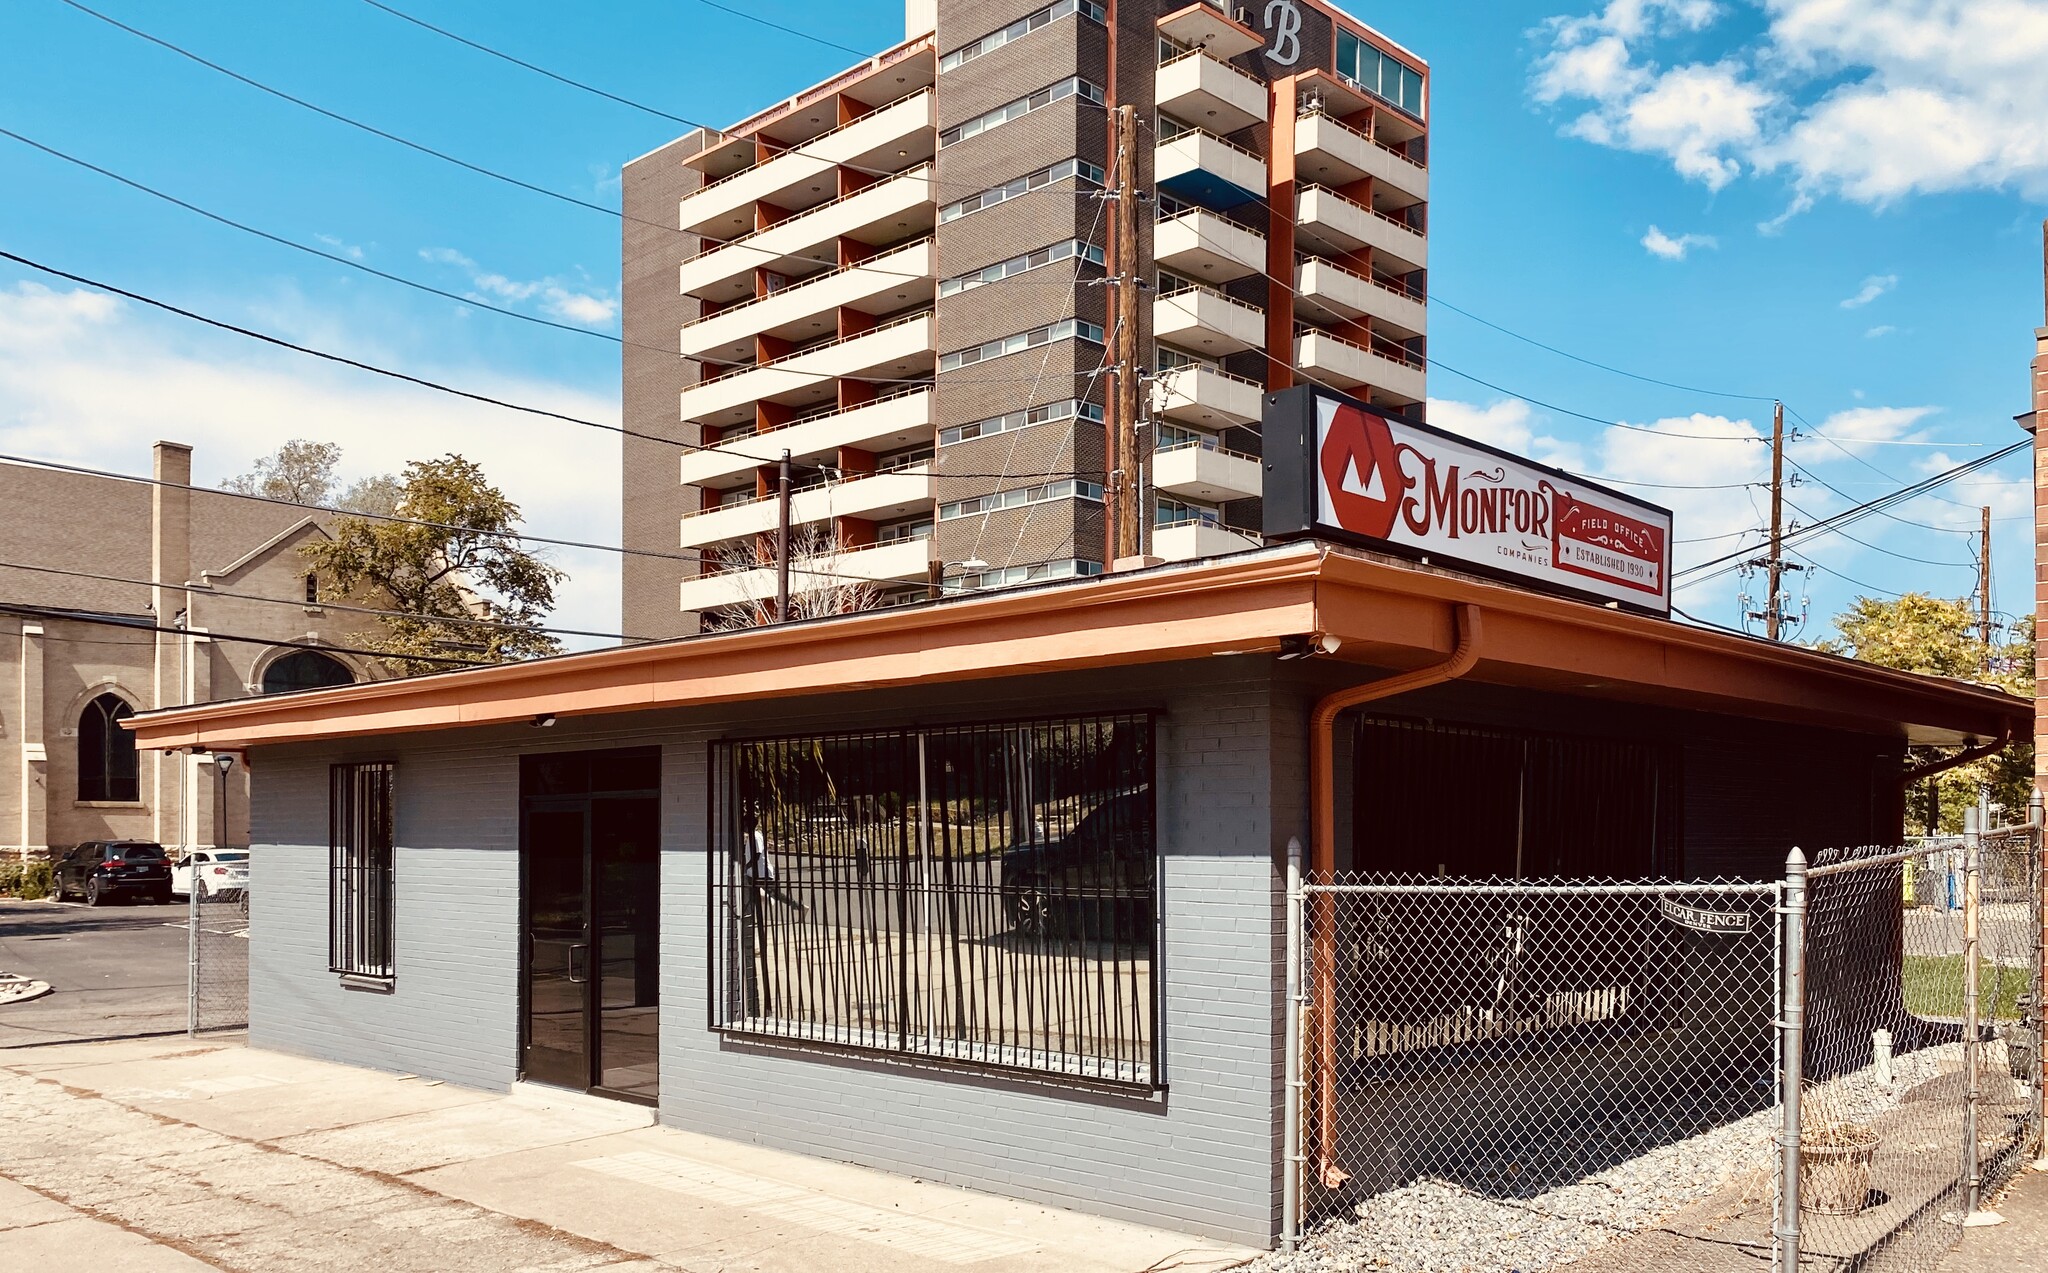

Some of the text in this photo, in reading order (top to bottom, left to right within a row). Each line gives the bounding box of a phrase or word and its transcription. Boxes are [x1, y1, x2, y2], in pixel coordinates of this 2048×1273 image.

[1264, 0, 1301, 66] B
[1582, 519, 1644, 548] FIELD OFFICE
[1497, 546, 1548, 567] COMPANIES
[1576, 547, 1625, 573] ESTABLISHED
[1664, 902, 1745, 926] ELCAR FENCE
[1685, 920, 1711, 929] DENVER
